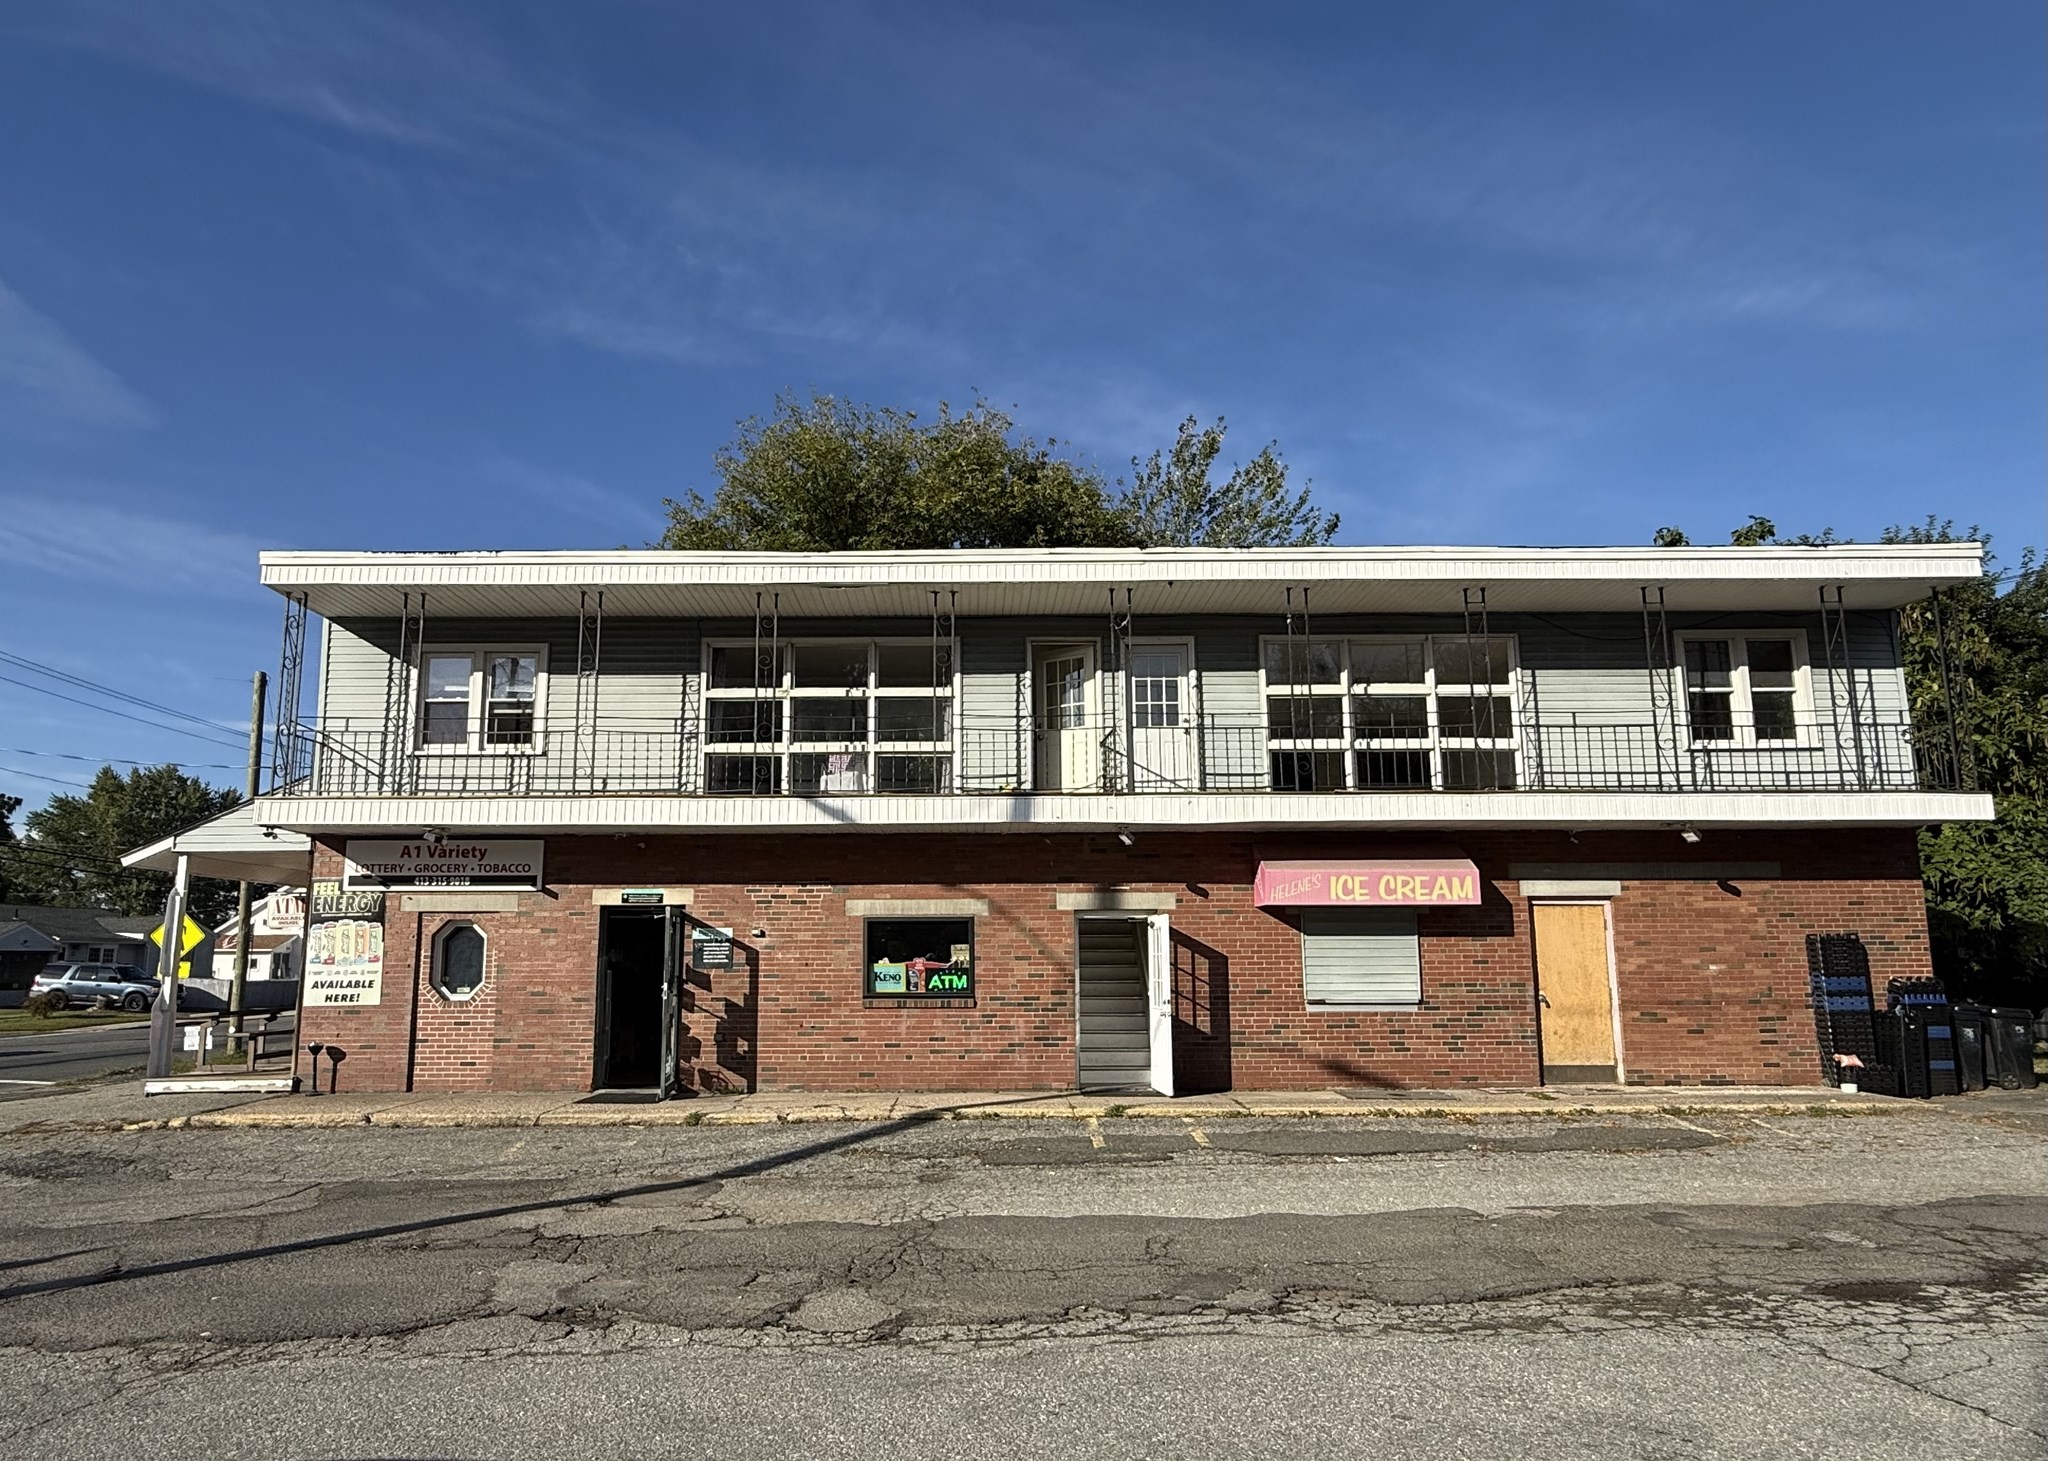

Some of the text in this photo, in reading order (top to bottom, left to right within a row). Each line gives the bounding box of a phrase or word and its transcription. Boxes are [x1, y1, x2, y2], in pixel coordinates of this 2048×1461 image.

[400, 845, 488, 862] A1 Variety
[355, 863, 531, 874] LOTTERY GROCERY TOBACCO
[313, 881, 341, 896] FEEL
[1270, 873, 1322, 902] HELENE'S
[1329, 875, 1370, 901] ICE
[1378, 874, 1473, 901] CREAM
[312, 893, 383, 914] ENERGY
[873, 971, 902, 982] KENO
[928, 974, 968, 989] ATM
[311, 979, 375, 990] AVAILABLE
[324, 993, 360, 1003] HERE!
